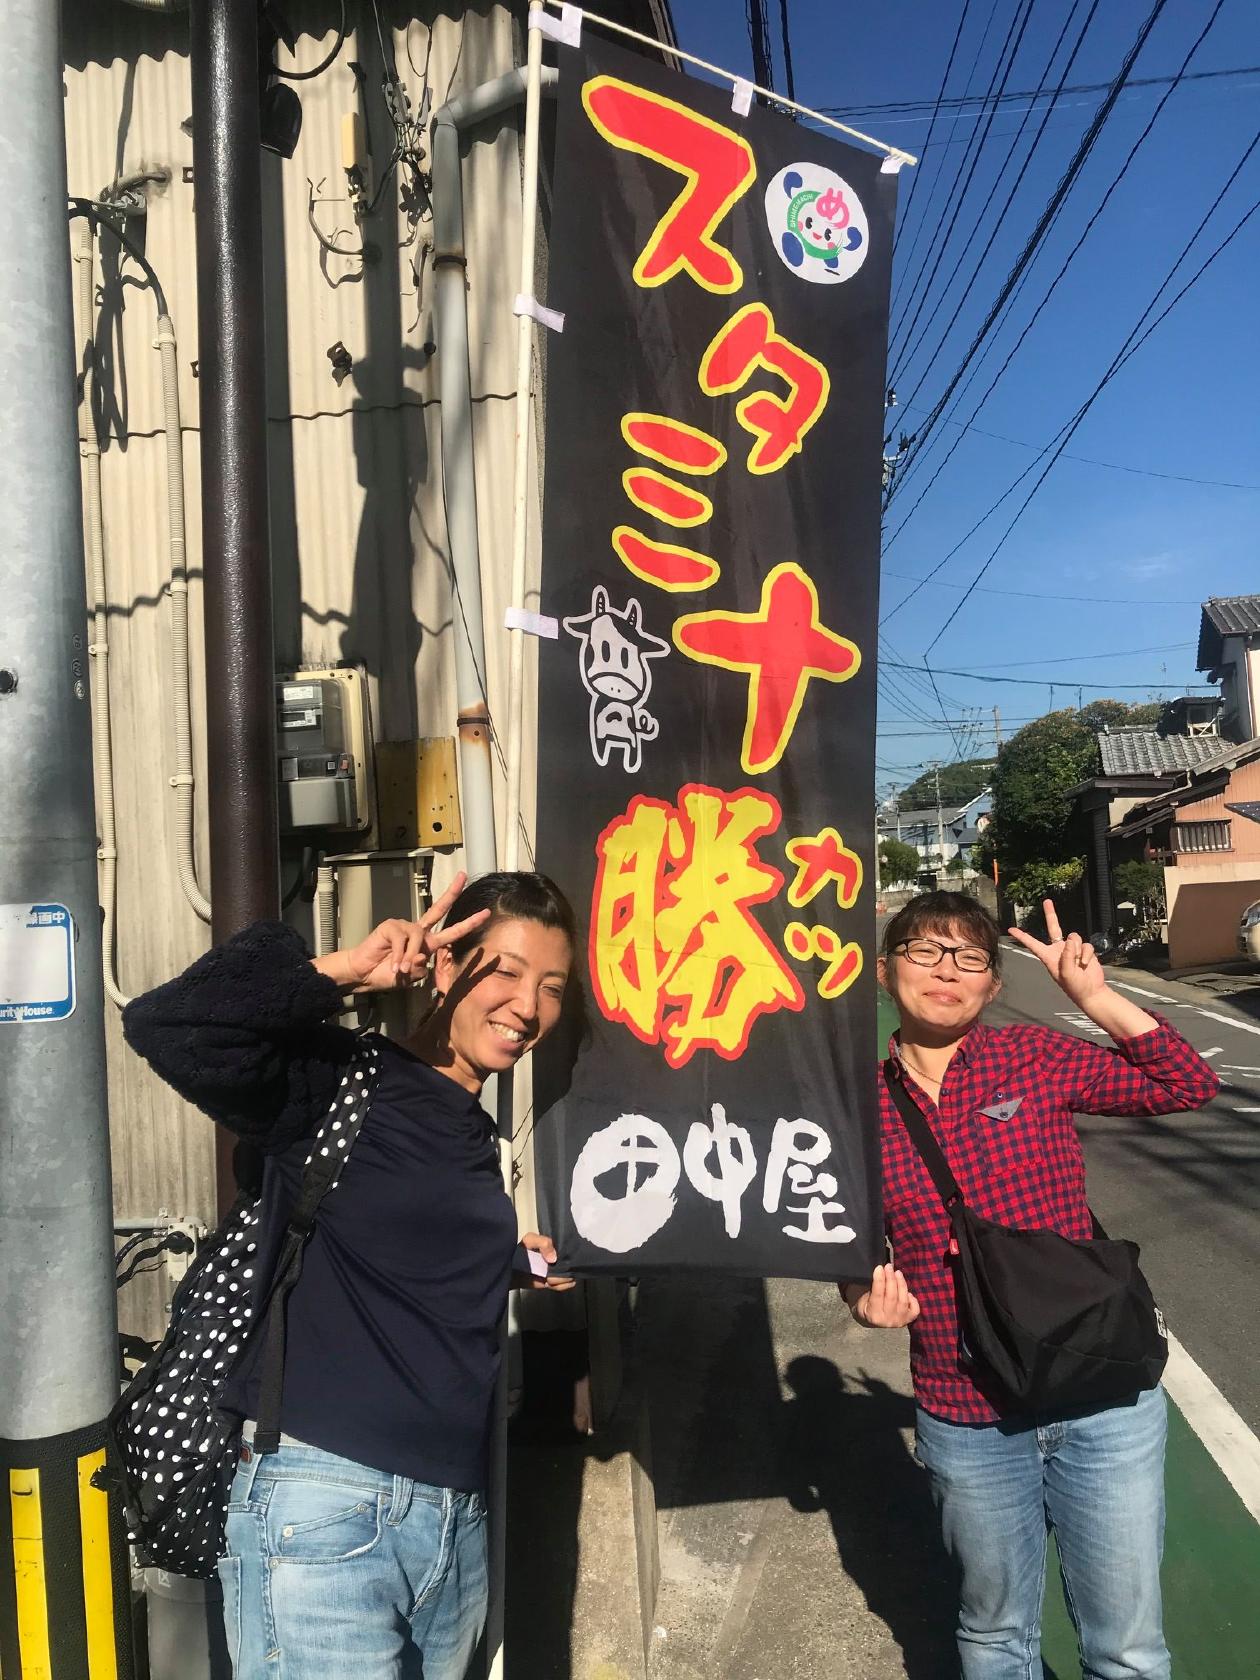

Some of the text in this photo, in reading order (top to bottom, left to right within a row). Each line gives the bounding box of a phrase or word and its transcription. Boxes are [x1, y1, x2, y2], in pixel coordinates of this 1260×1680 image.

[784, 827, 863, 999] カツ
[570, 1103, 856, 1253] 田中屋
